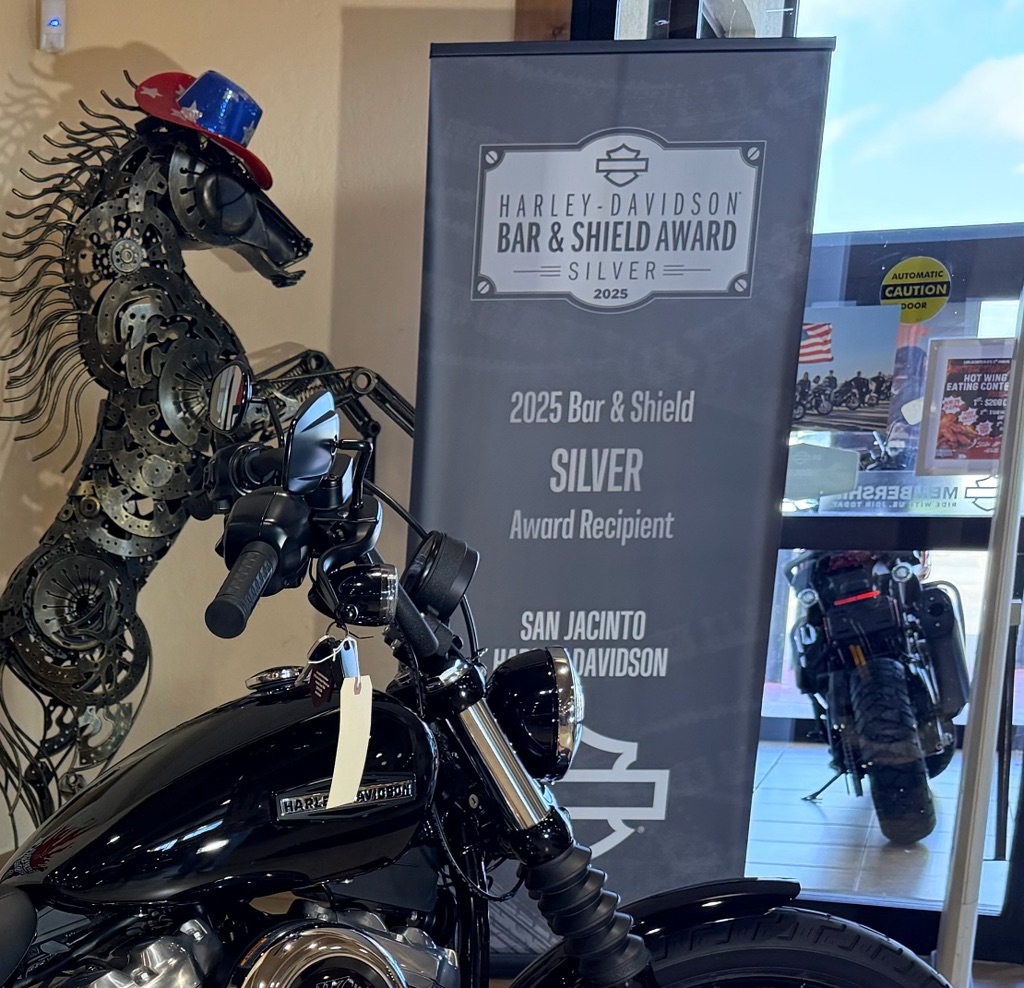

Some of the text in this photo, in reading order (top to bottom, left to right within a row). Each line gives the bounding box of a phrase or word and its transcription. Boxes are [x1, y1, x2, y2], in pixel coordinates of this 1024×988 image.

[499, 192, 738, 218] HARLEY-DAVIDSON
[497, 219, 737, 253] BAR & SHIELD AWARD
[568, 261, 656, 281] SILVER
[892, 270, 944, 280] AUTOMATIC
[593, 288, 629, 300] 2025
[884, 284, 947, 298] CAUTION
[901, 302, 927, 310] DOOR
[946, 382, 978, 391] EATING
[963, 373, 982, 382] HOT
[509, 390, 695, 424] 2025 Bar & Shield
[549, 447, 644, 493] SILVER
[509, 509, 675, 546] Award Recipient
[520, 609, 646, 641] SAN JACINTO
